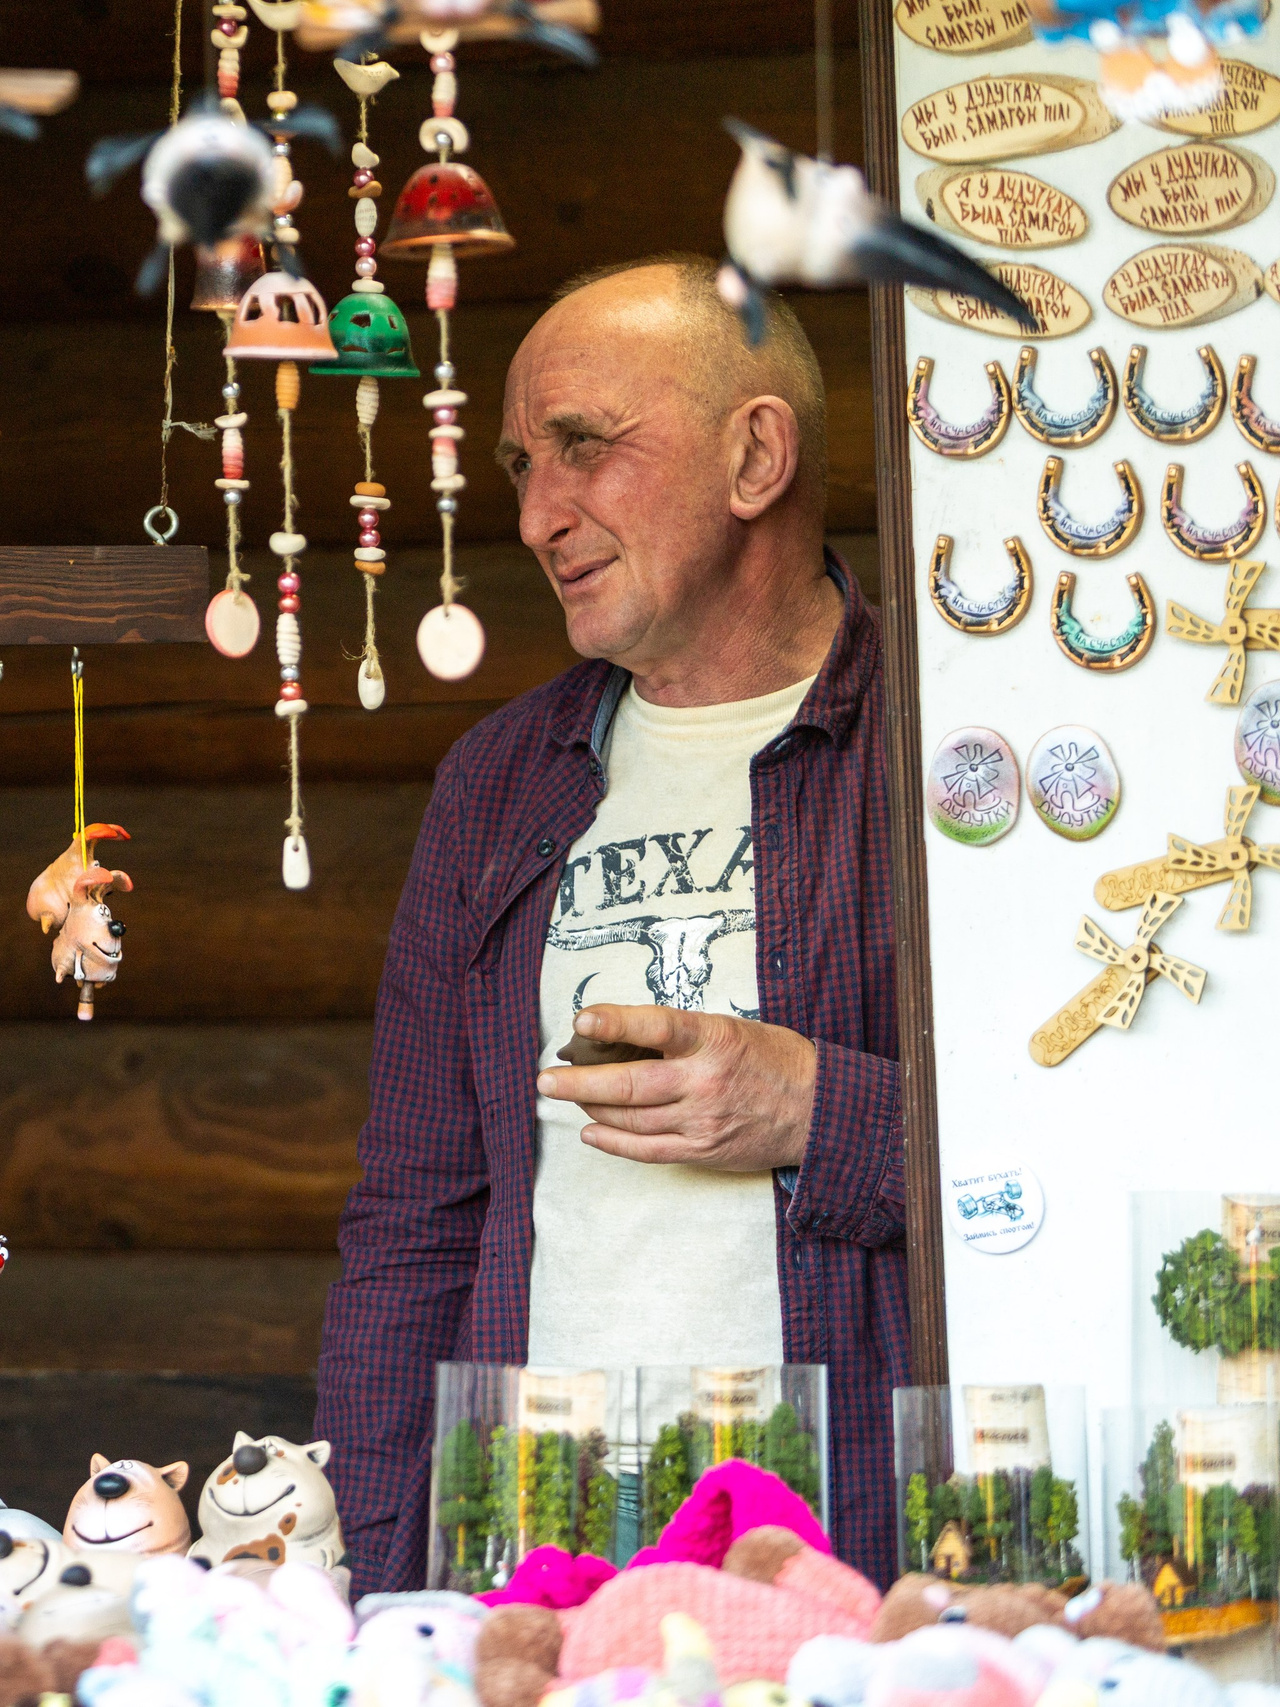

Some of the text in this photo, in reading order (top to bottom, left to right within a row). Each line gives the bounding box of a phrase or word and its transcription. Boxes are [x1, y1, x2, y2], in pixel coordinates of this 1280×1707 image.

[926, 18, 996, 47] САМАГОН
[912, 100, 938, 131] МЫ
[965, 81, 1042, 113] ДУДУТКАХ
[966, 105, 1037, 138] САМАГОН
[1044, 103, 1070, 123] ПІЛІ
[1209, 113, 1236, 133] ПІЛІ
[1117, 170, 1147, 203] МЫ
[1165, 151, 1239, 185] ДУДУТКАХ
[955, 178, 971, 198] Я
[993, 175, 1075, 221] ДУДУТКАХ
[1140, 187, 1242, 229] САМАГОН ПІЛІ
[997, 227, 1032, 244] ПІЛА
[1008, 203, 1077, 239] САМАГОН
[1109, 279, 1121, 298] Я
[1133, 252, 1209, 286] ДУДУТКАХ
[1161, 270, 1230, 300] САМАГОН
[1157, 297, 1195, 323] ПІЛА
[938, 798, 1014, 827] ДУДУТКИ
[1037, 797, 1115, 828] ДУДУТКИ
[952, 1176, 985, 1188] Хватит
[963, 1231, 998, 1242] Займись
